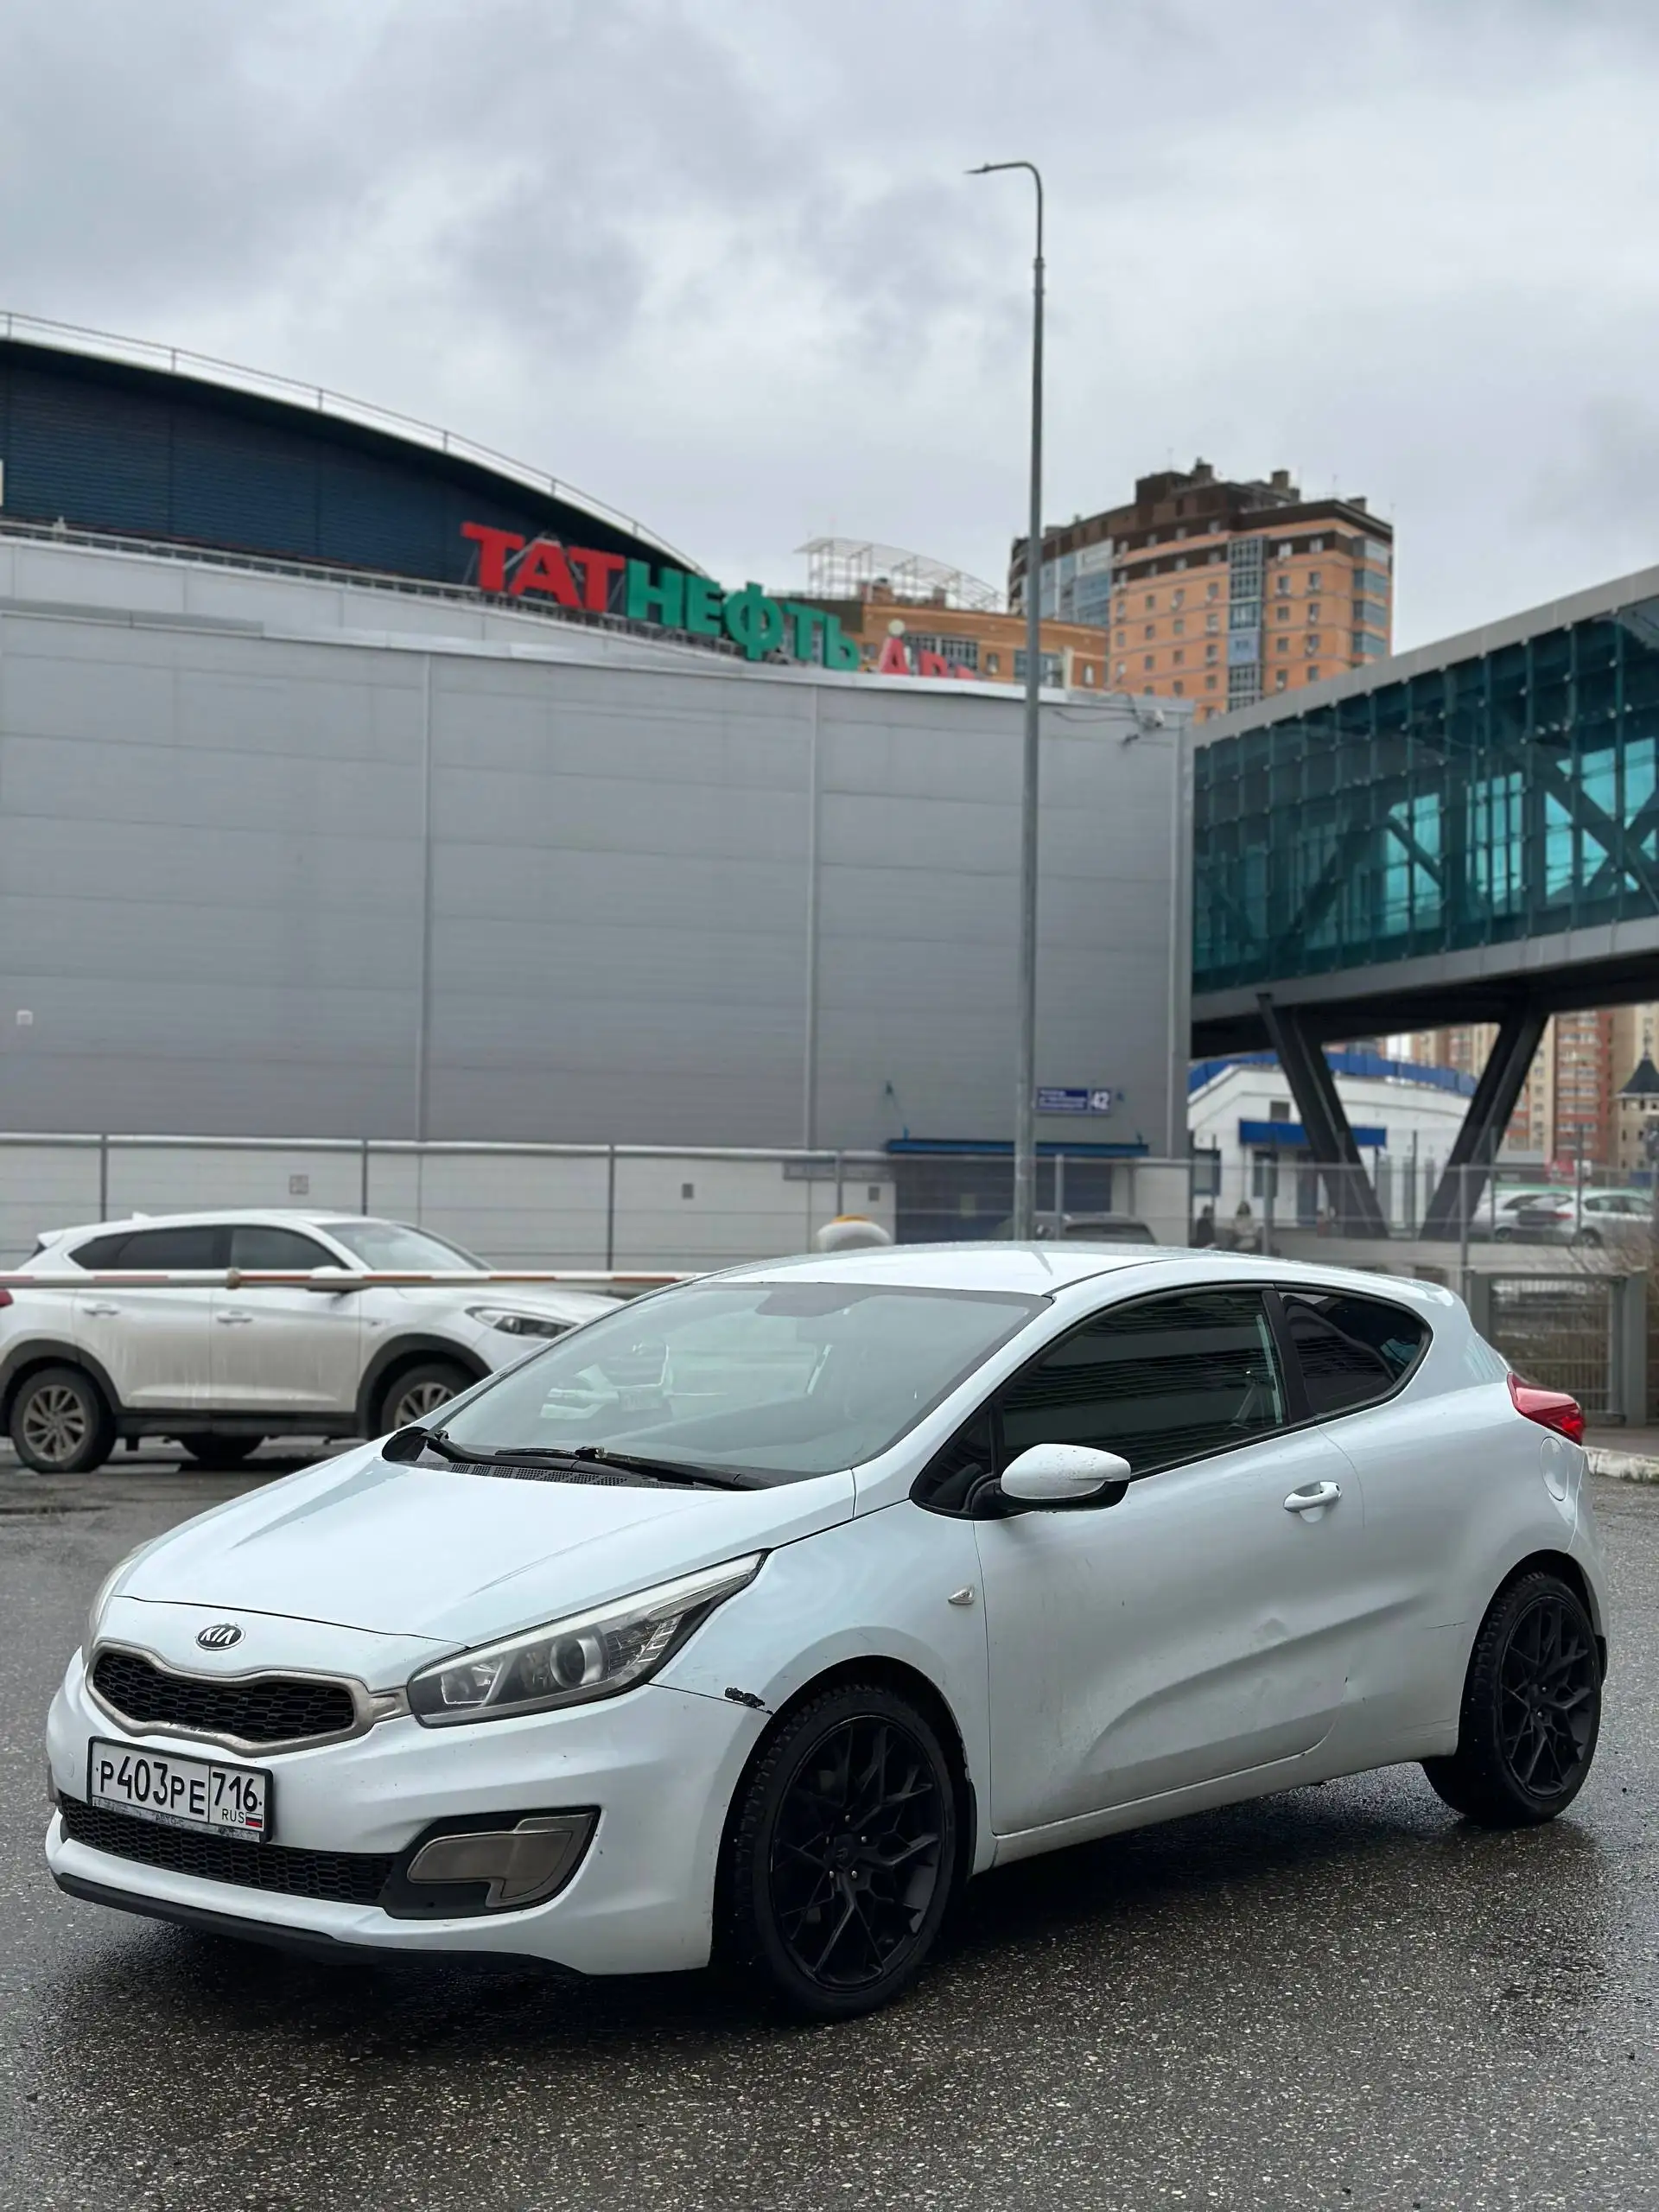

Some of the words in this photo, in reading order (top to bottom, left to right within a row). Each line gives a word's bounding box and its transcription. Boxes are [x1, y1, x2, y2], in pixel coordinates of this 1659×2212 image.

[461, 522, 860, 671] ТАТНЕФТЬ
[1090, 1090, 1110, 1110] 42
[200, 1626, 236, 1645] KIA
[220, 1808, 245, 1824] RUS
